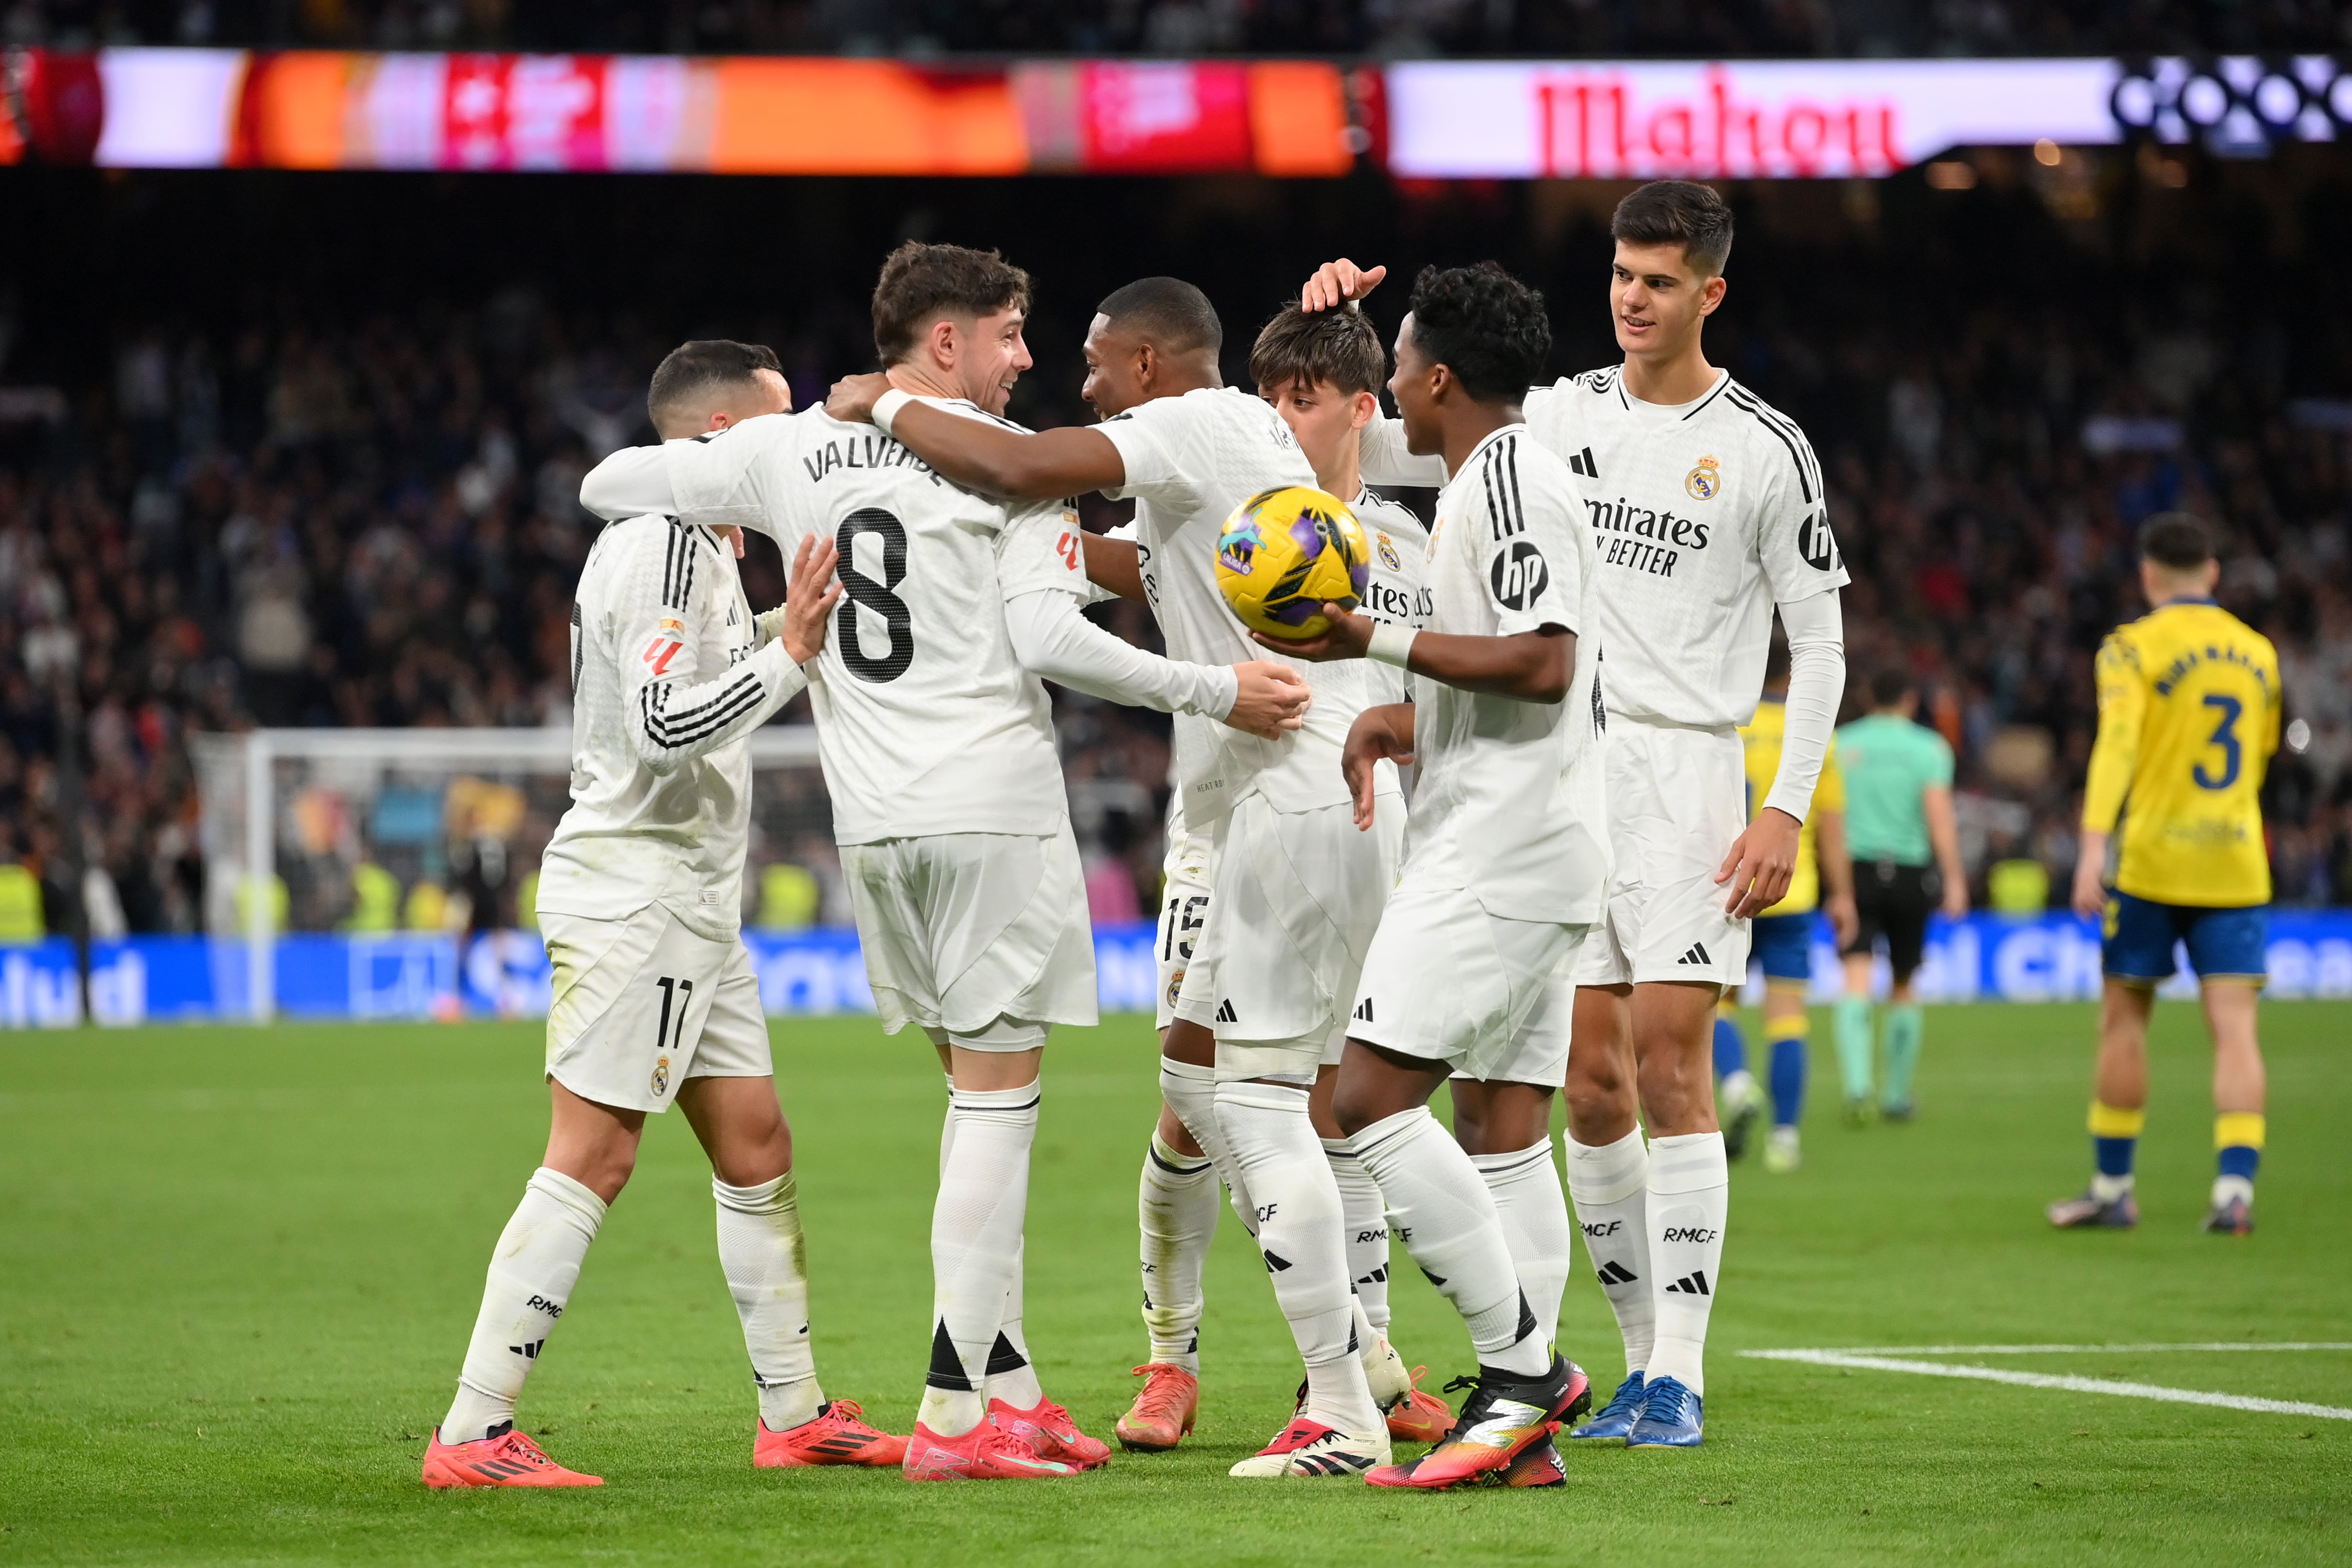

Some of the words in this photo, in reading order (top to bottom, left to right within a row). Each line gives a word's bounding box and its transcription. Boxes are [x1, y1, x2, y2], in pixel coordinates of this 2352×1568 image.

[1534, 61, 1913, 178] Mahou
[1583, 497, 1709, 550] mirates
[1223, 553, 1242, 570] LALIGA
[1500, 542, 1544, 611] hp
[1606, 538, 1678, 577] BETTER
[836, 507, 914, 683] 8
[2193, 694, 2241, 790] 3
[1164, 896, 1210, 962] 15
[656, 976, 693, 1049] 17
[1256, 1203, 1278, 1222] CF
[1581, 1220, 1622, 1237] MCF
[1662, 1227, 1718, 1244] RMCF
[526, 1295, 562, 1319] RMC
